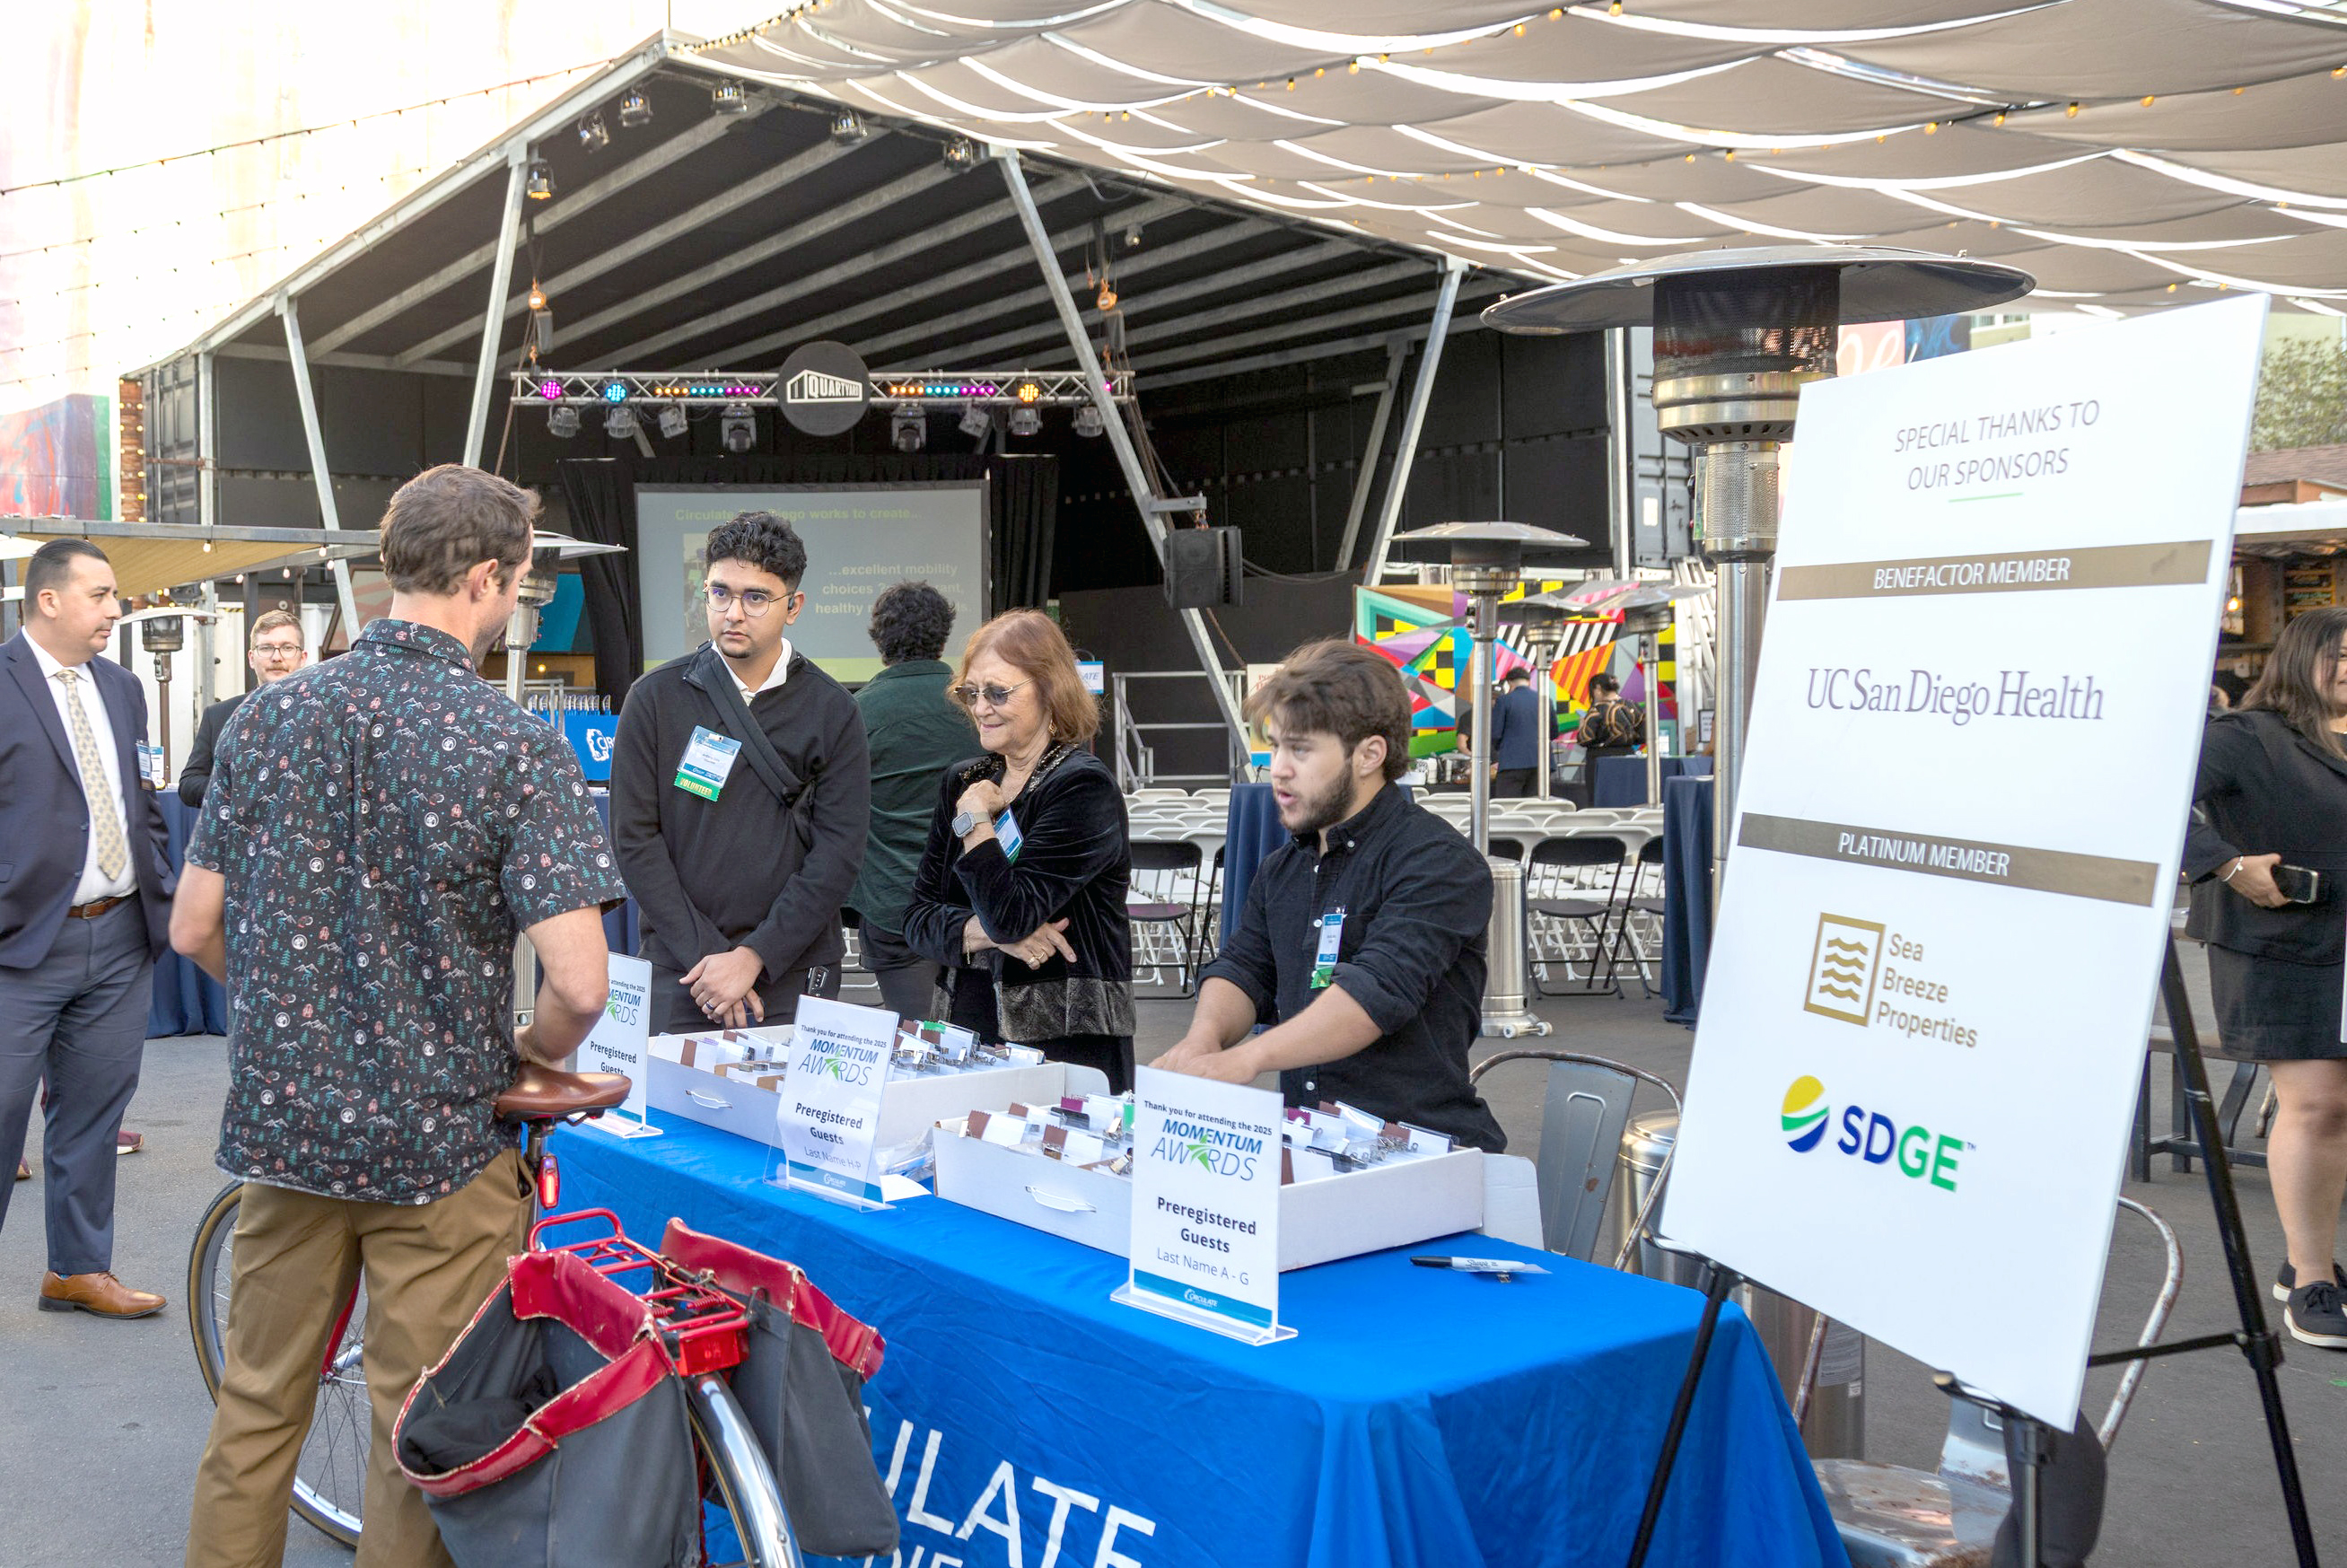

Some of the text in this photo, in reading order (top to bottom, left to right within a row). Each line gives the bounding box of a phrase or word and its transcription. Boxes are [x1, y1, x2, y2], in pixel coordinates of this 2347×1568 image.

[809, 375, 859, 399] QUARTYARD
[1895, 399, 2100, 452] SPECIAL THANKS TO
[1907, 448, 2070, 491] OUR SPONSORS
[810, 509, 849, 520] works
[854, 509, 865, 519] to
[906, 564, 959, 577] mobility
[1874, 557, 2071, 590] BENEFACTOR MEMBER
[822, 583, 873, 594] choices
[815, 603, 863, 616] healthy
[1808, 668, 2105, 726] UC San Diego Health
[1837, 832, 2010, 877] PLATINUM MEMBER
[1888, 933, 1924, 962] Sea
[1882, 967, 1949, 1004] Breeze
[801, 1024, 816, 1034] Thank
[828, 1029, 836, 1038] for
[836, 1032, 863, 1045] attending
[863, 1038, 873, 1046] the
[873, 1039, 887, 1048] 2025
[1876, 1001, 1978, 1049] Properties
[590, 1040, 637, 1064] Preregistered
[810, 1038, 879, 1064] MOMENTUM
[795, 1102, 863, 1130] Preregistered
[1144, 1100, 1273, 1135] Thank you for attending the 2025
[810, 1126, 845, 1145] Guests
[1162, 1119, 1263, 1154] MOMENTUM
[1837, 1104, 1965, 1193] SDGE
[804, 1146, 821, 1161] Last
[822, 1152, 846, 1167] Name
[1157, 1196, 1257, 1235] Preregistered
[1180, 1228, 1230, 1253] Guests
[1157, 1248, 1181, 1266] Last
[1183, 1255, 1218, 1276] Name
[1221, 1266, 1230, 1279] A
[1239, 1271, 1249, 1285] G
